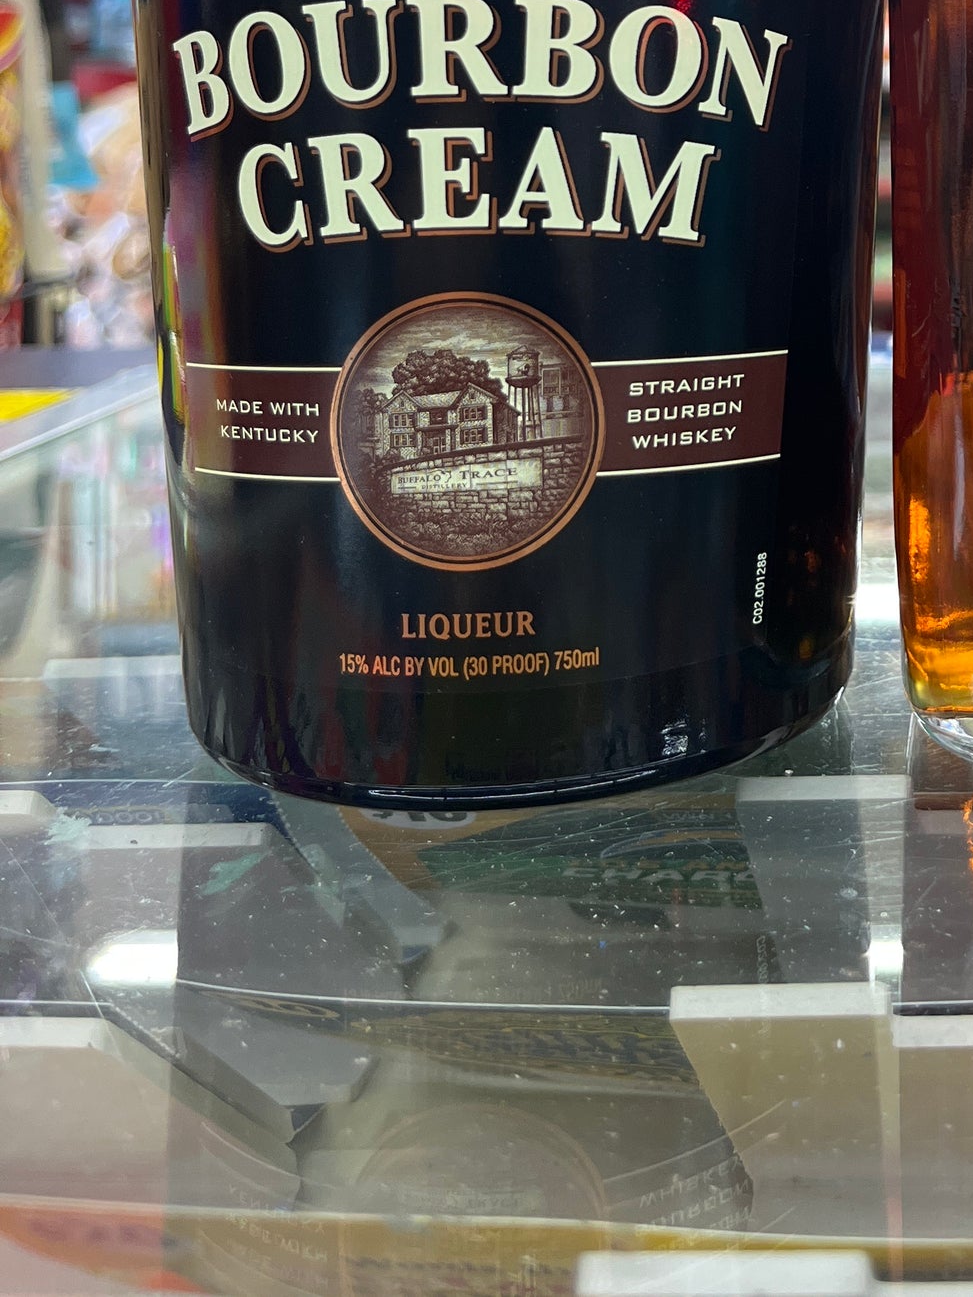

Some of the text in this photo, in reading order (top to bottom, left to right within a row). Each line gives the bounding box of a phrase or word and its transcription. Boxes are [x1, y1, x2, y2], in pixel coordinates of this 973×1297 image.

[238, 126, 720, 253] CREAM
[628, 373, 746, 397] STRAIGHT
[215, 398, 321, 418] MADE WITH
[626, 399, 743, 424] BOURBON
[219, 424, 320, 445] KENTUCKY
[631, 425, 738, 450] WHISKEY
[459, 467, 518, 481] TRACE
[752, 551, 768, 626] C02.001288
[401, 610, 537, 641] LIQUEUR
[339, 646, 600, 681] 15% ALC BY VOL (30 PROOF) 750ml
